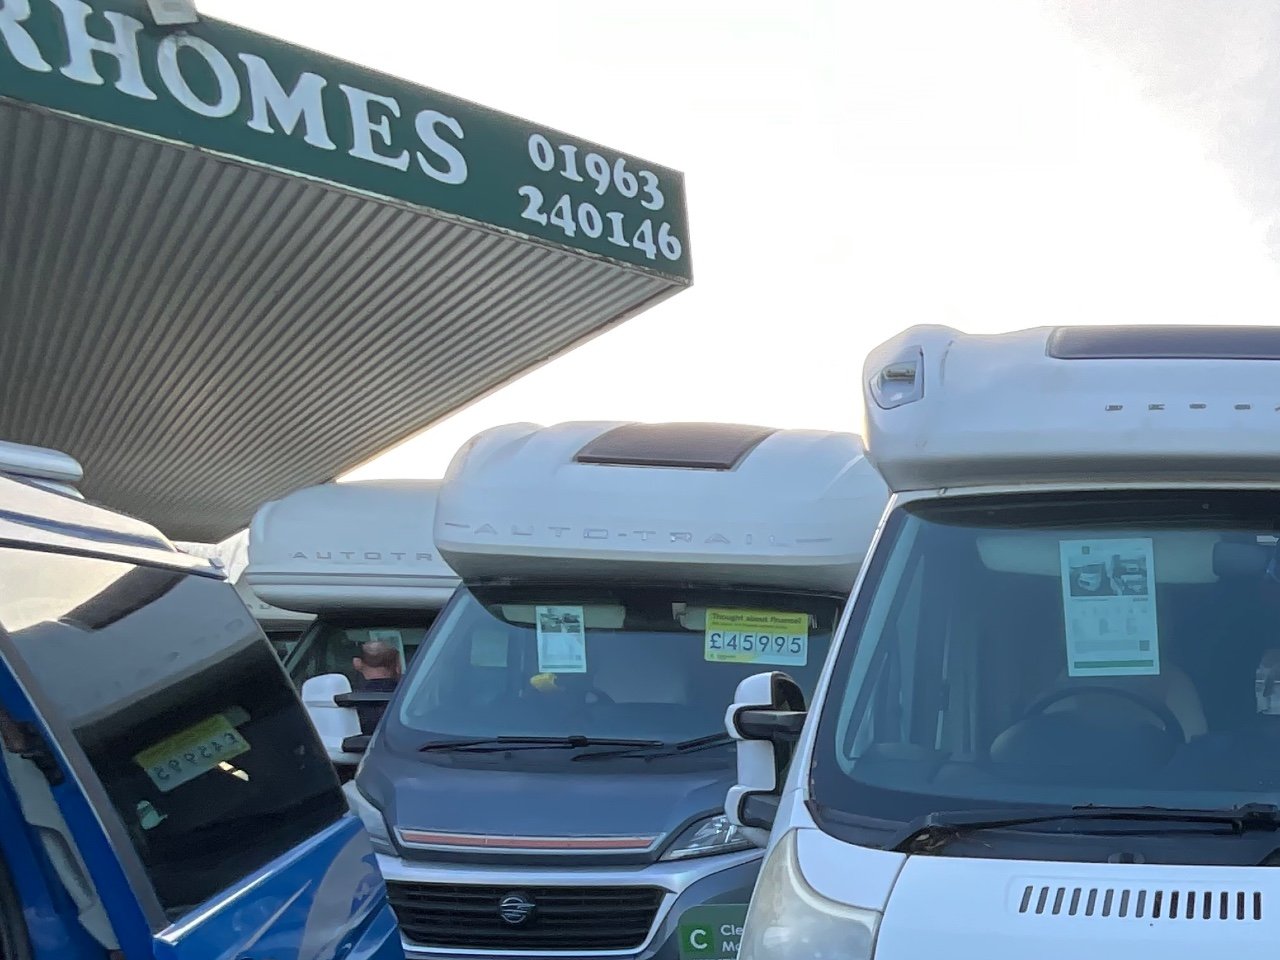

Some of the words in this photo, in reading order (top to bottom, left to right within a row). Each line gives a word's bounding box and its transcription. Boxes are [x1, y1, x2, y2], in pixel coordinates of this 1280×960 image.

[528, 133, 664, 211] 01963
[518, 185, 682, 261] 240146
[710, 632, 802, 654] £45995
[690, 929, 708, 949] C
